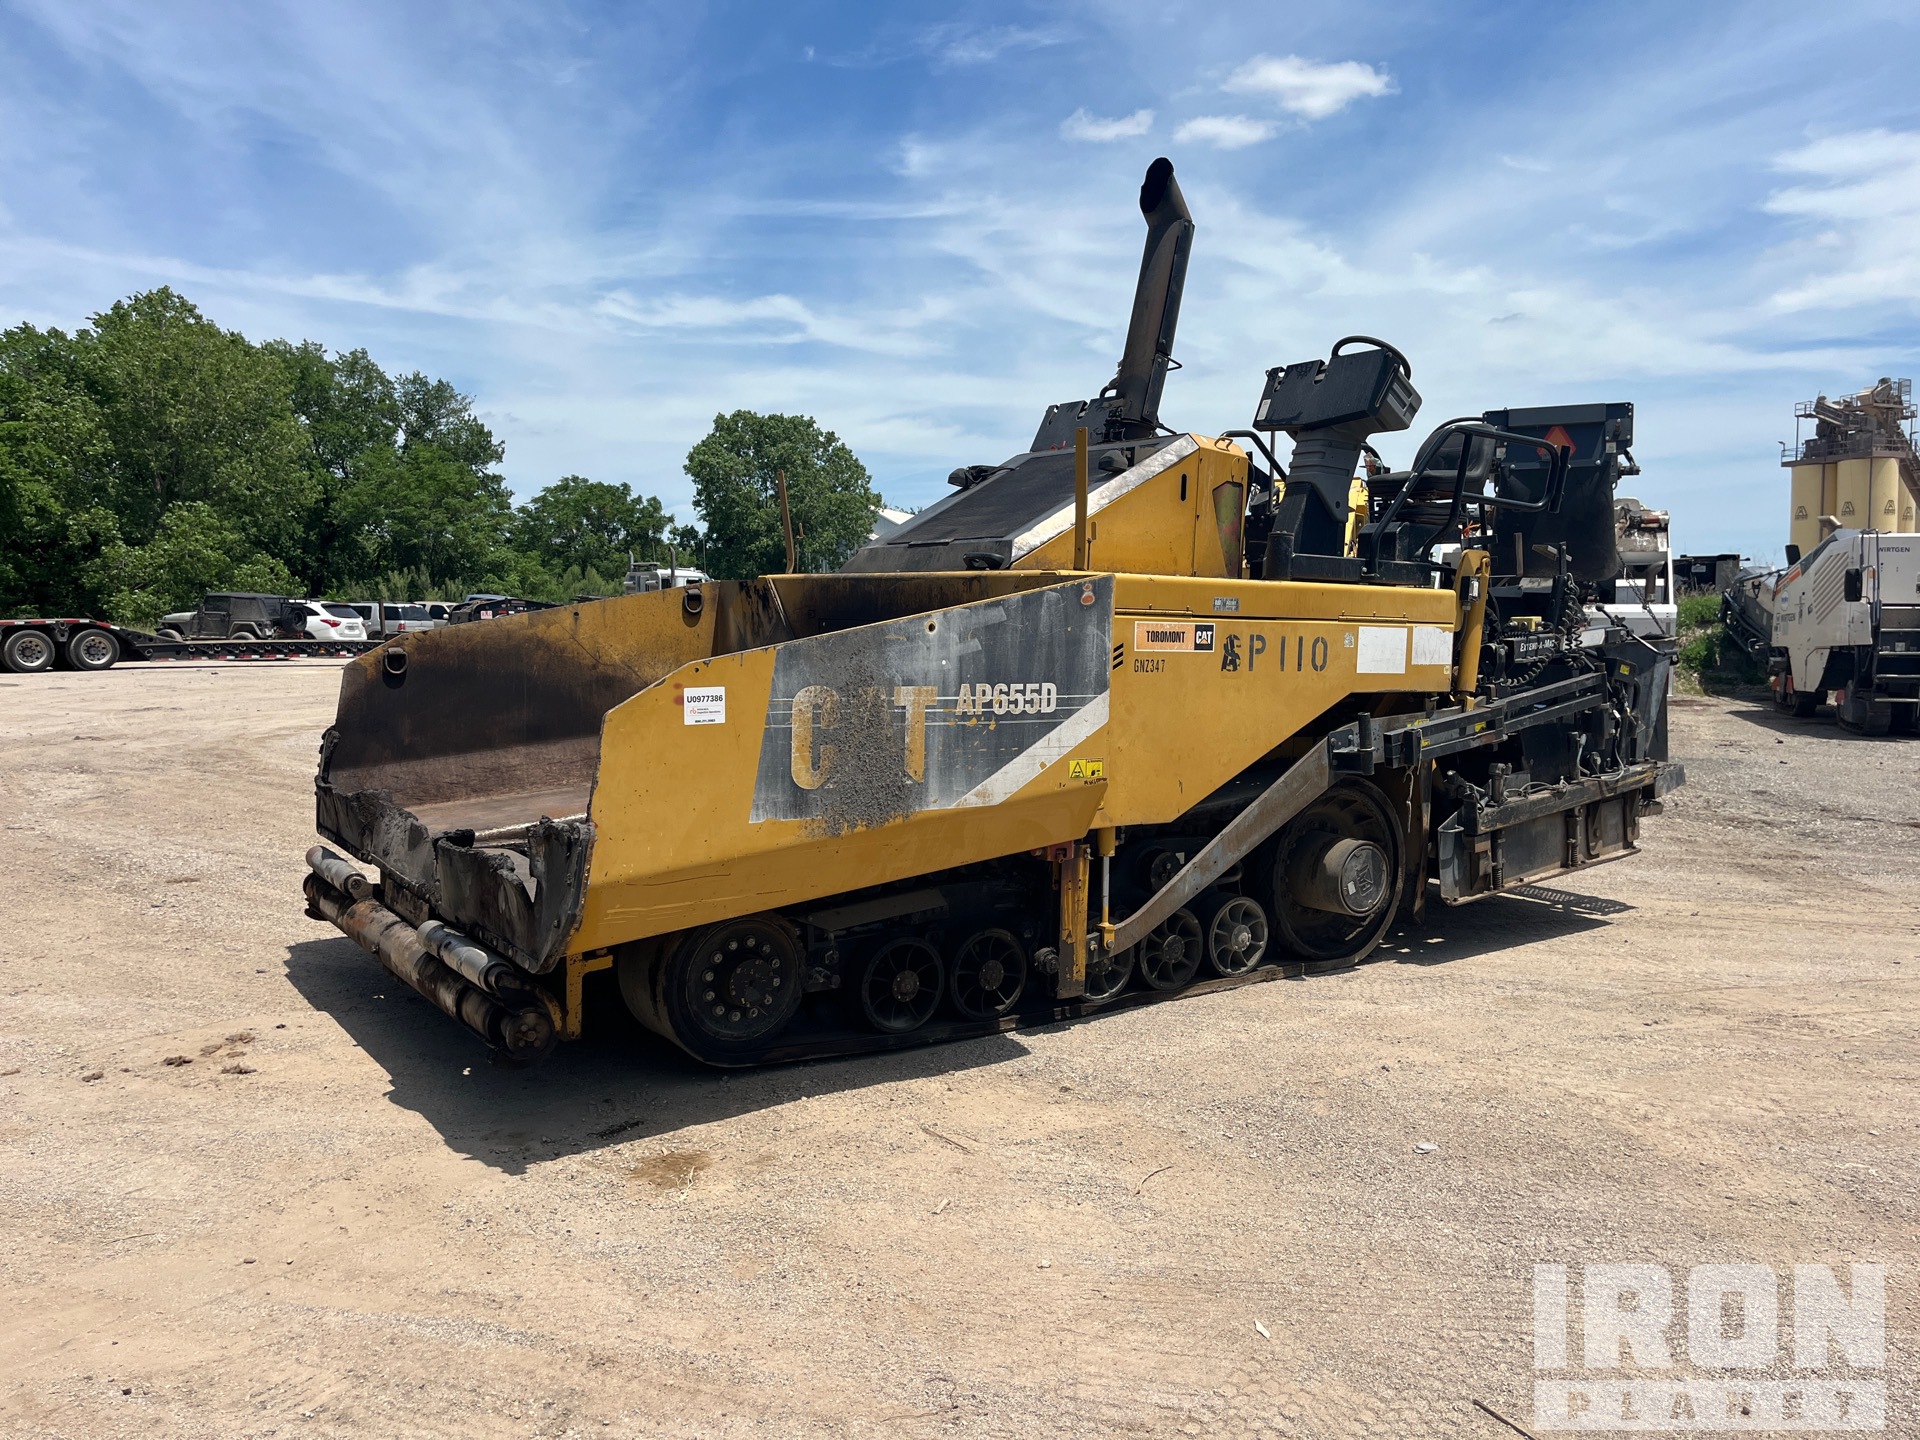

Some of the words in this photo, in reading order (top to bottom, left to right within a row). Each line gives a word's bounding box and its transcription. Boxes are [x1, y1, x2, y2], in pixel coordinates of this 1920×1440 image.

[1146, 630, 1186, 644] TOROMONT
[1195, 630, 1213, 645] CAT
[1133, 658, 1166, 674] GNZ347
[686, 694, 724, 704] U0977386
[955, 681, 1058, 716] AP655D
